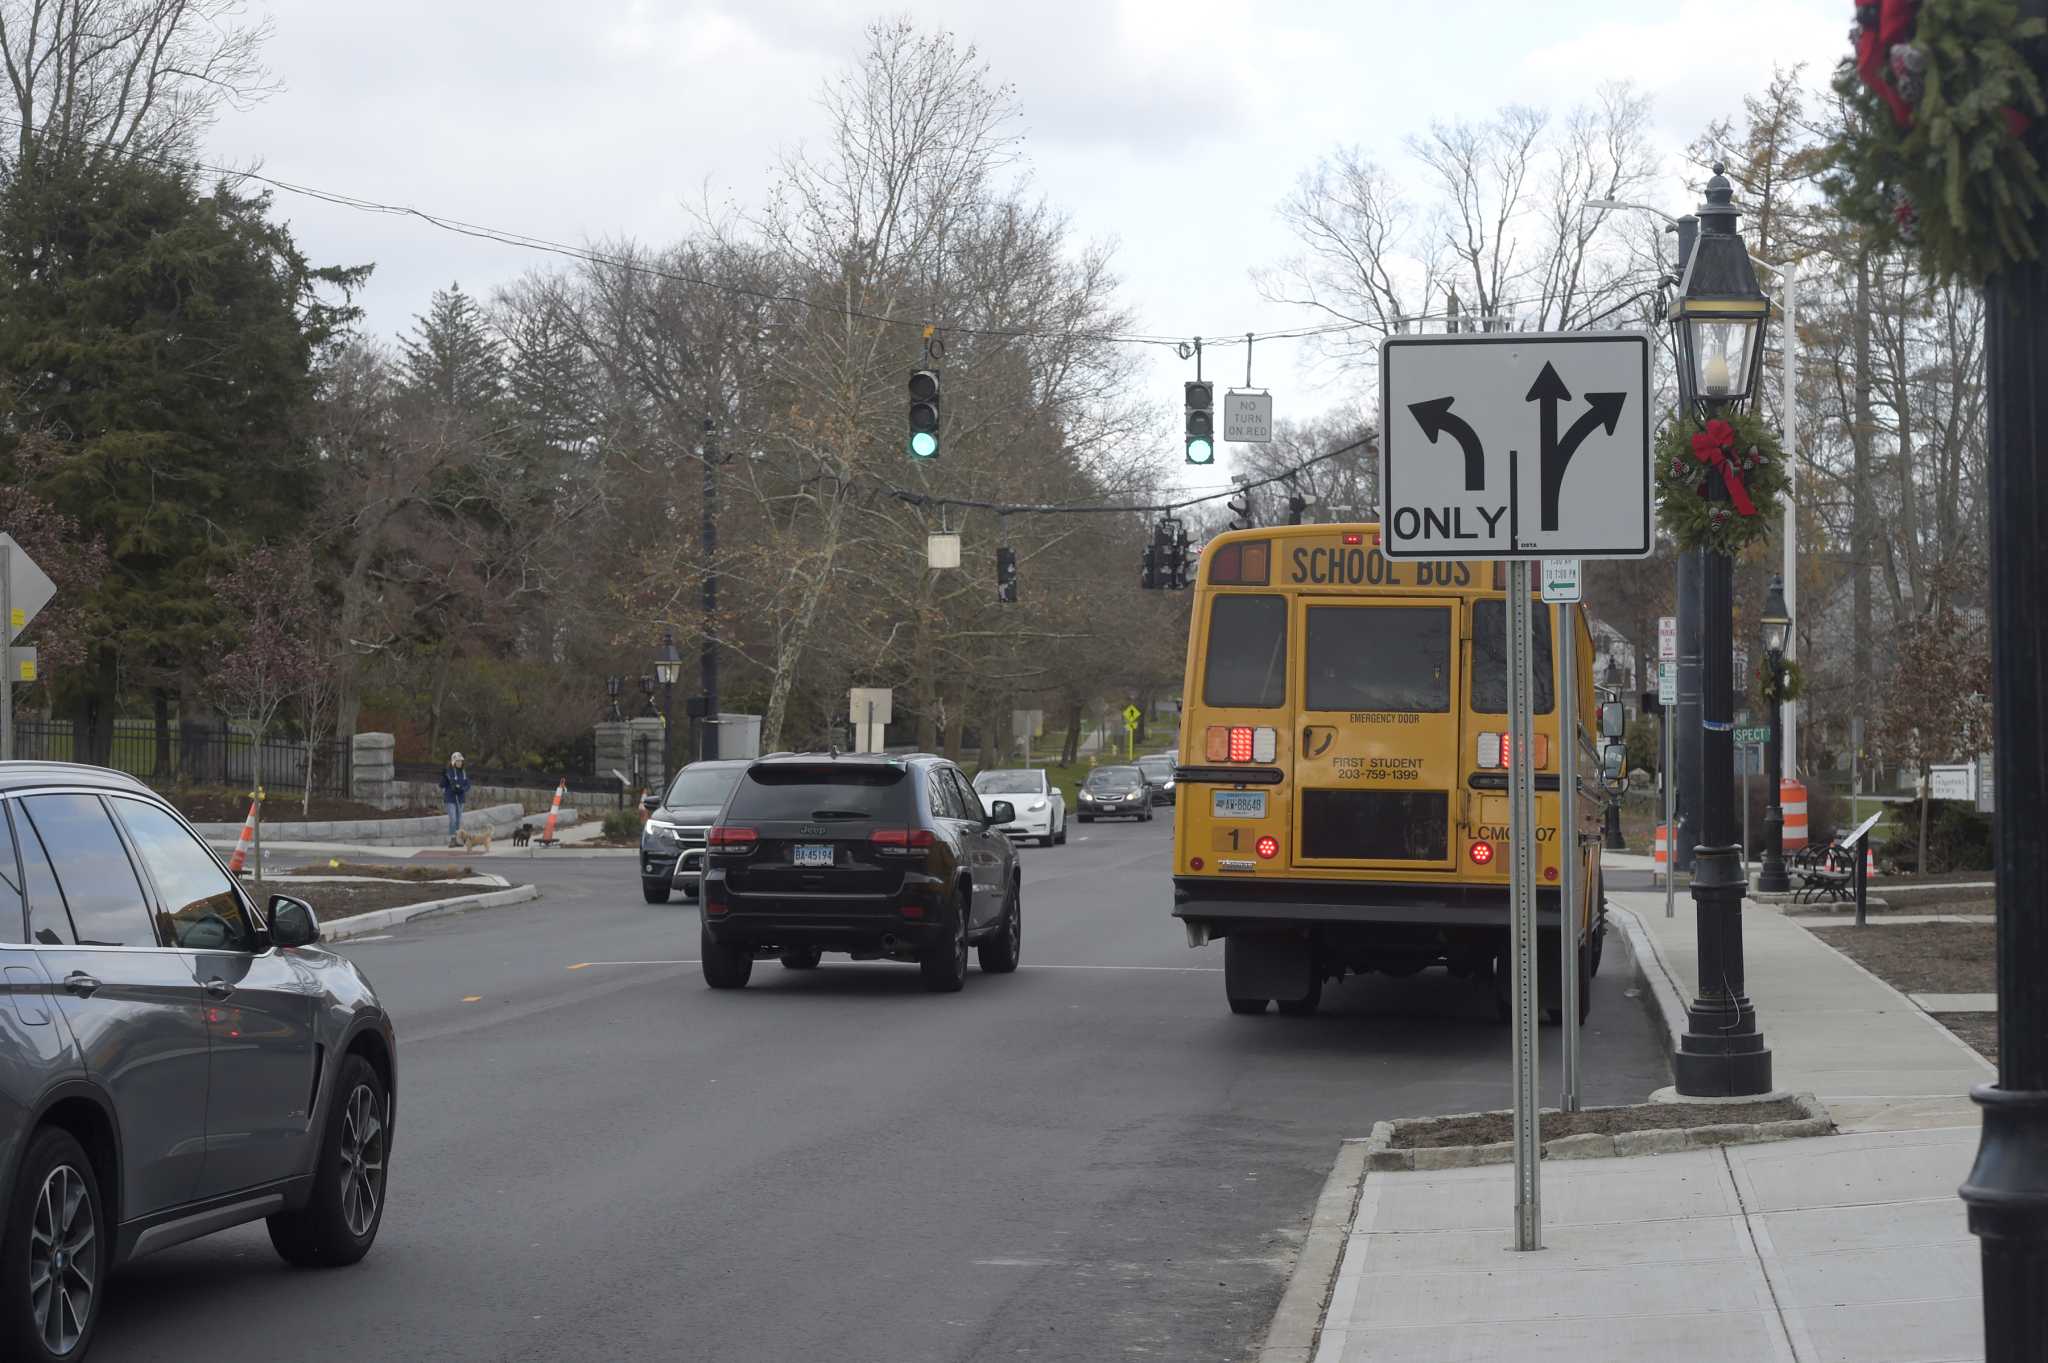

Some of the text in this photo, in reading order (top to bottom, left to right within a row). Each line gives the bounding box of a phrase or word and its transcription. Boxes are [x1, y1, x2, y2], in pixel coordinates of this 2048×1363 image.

[1240, 401, 1256, 411] NO
[1234, 414, 1262, 423] TURN
[1228, 426, 1267, 436] ON RED
[1393, 506, 1508, 540] ONLY
[1291, 547, 1471, 586] SCHOOL BUS
[1350, 713, 1420, 724] EMERGENCY DOOR
[1733, 728, 1765, 741] SPECT
[1333, 757, 1424, 768] FIRST STUDENT
[1338, 769, 1418, 780] 203-759-1399
[1227, 829, 1239, 850] 1
